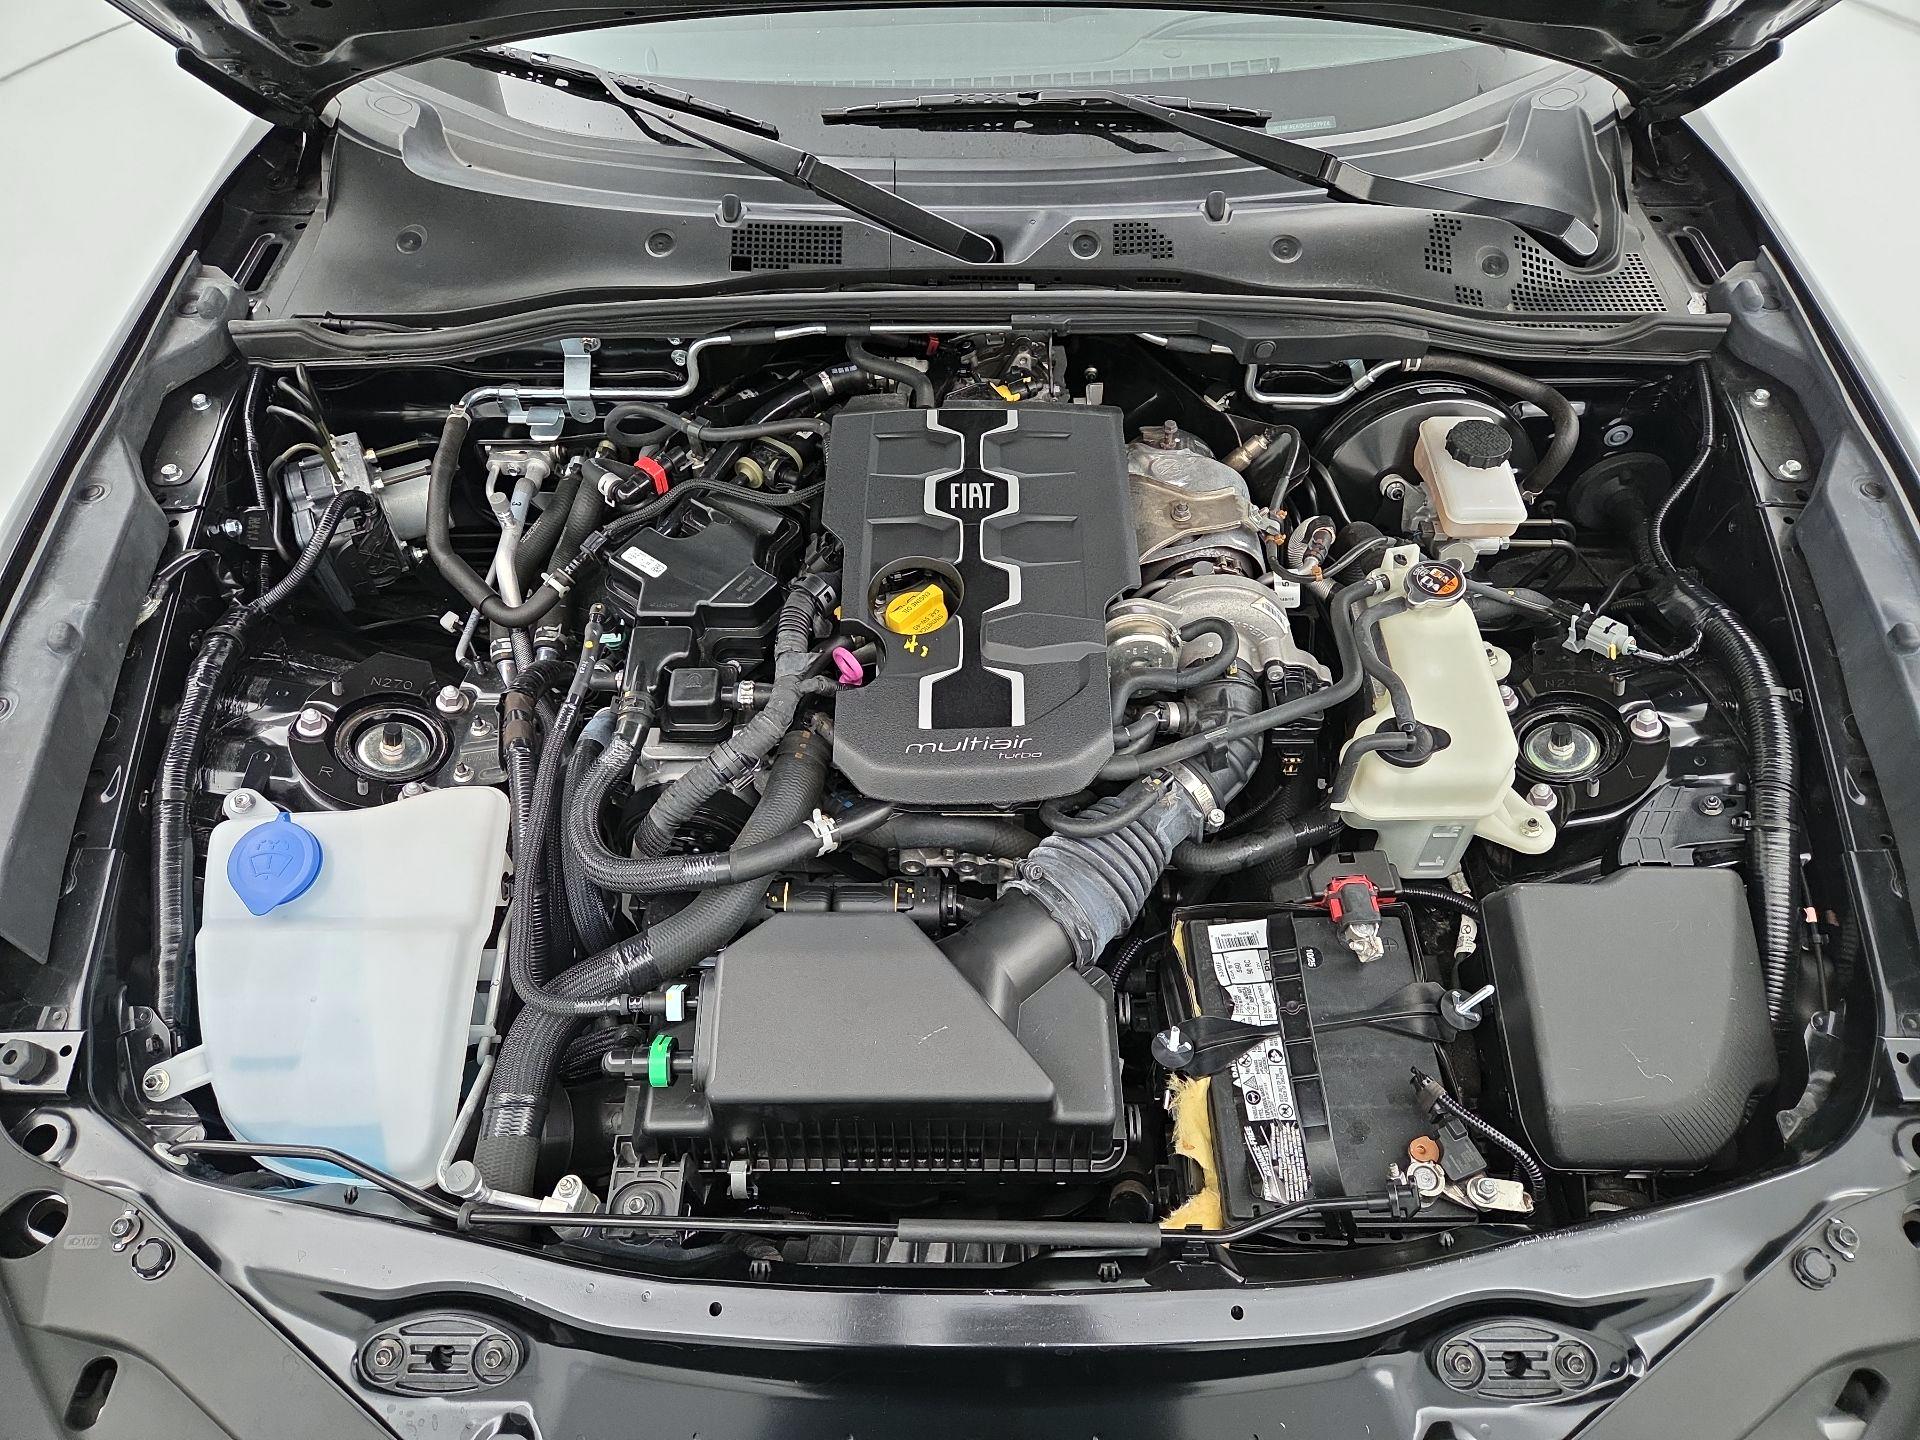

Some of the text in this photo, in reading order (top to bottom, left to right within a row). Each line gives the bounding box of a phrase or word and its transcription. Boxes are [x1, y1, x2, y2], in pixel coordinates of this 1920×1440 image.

[949, 482, 995, 509] FIAT
[370, 676, 413, 690] N270
[905, 734, 1033, 754] multiair
[998, 751, 1043, 760] turbo
[318, 765, 334, 778] R
